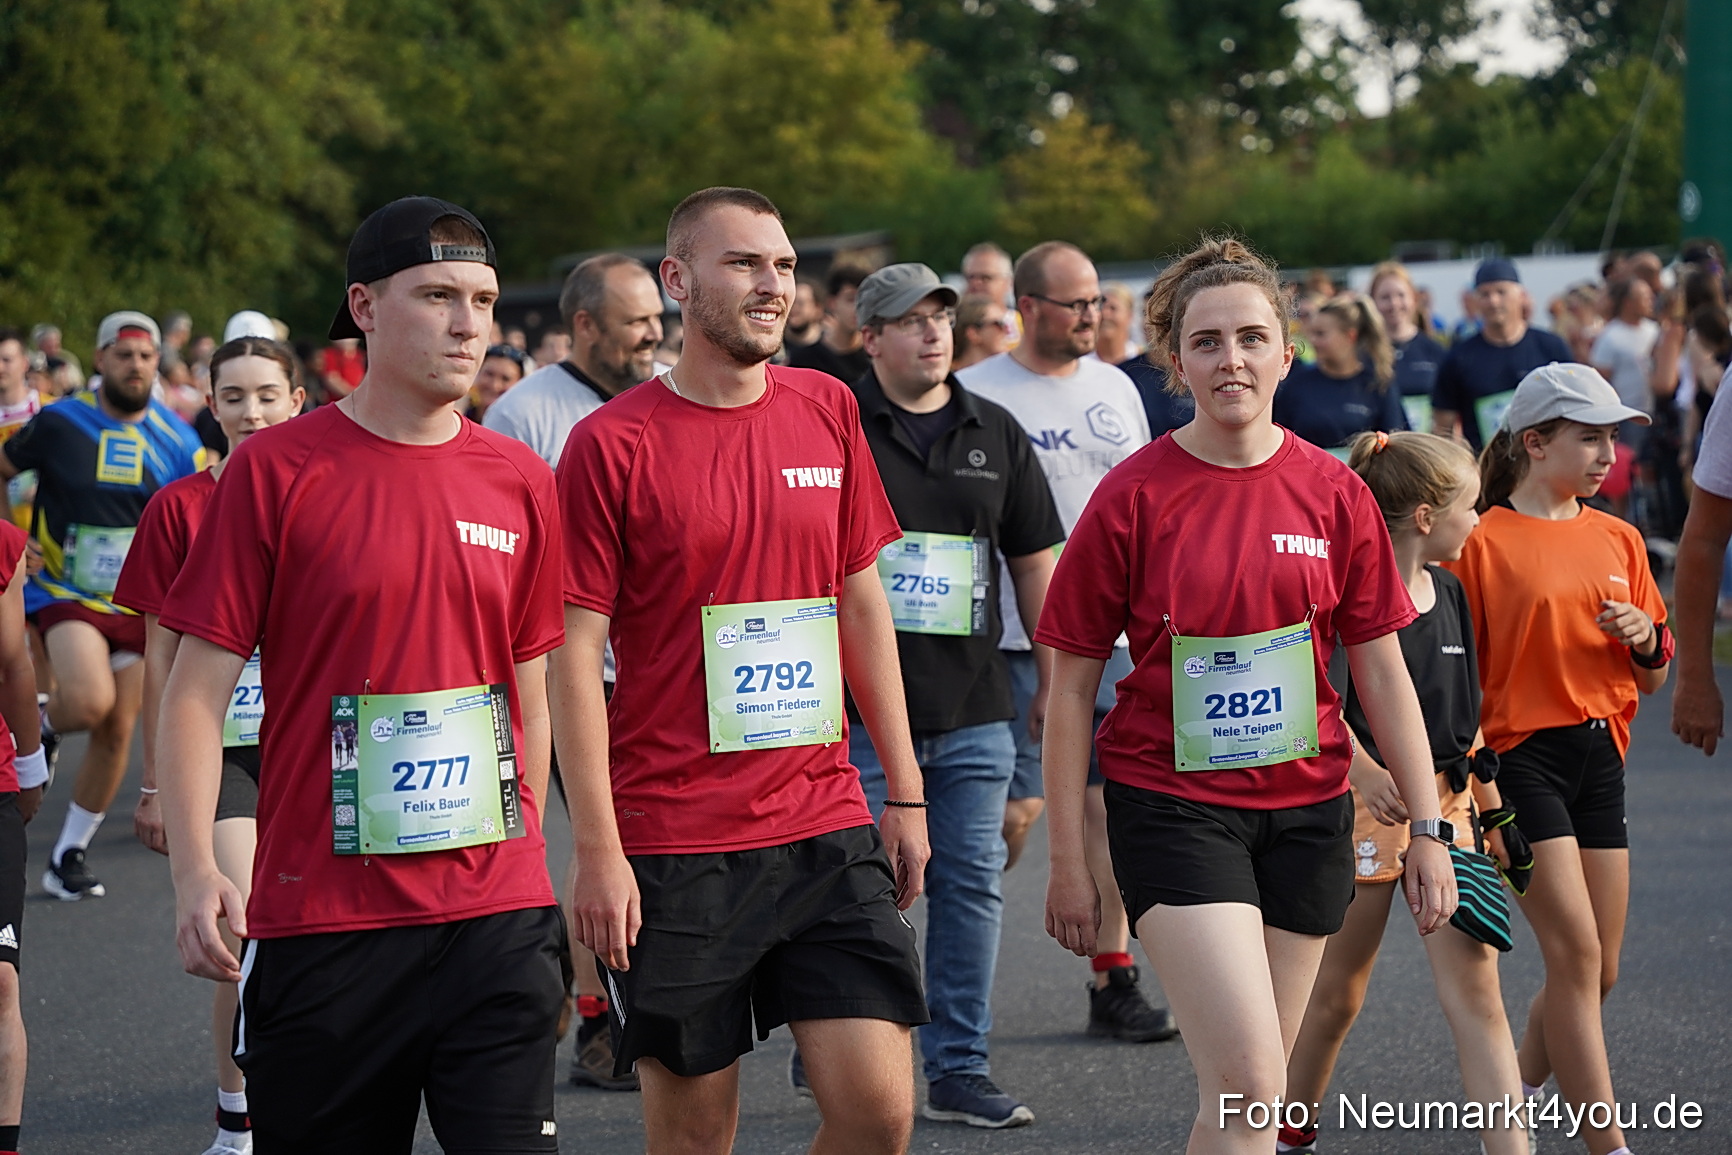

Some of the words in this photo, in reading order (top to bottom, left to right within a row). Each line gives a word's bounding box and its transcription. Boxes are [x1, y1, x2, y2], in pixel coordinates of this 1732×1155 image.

[455, 520, 517, 556] THULE
[1271, 534, 1328, 560] THUL
[891, 573, 950, 595] 2765
[739, 629, 781, 642] Firmenlauf
[756, 637, 781, 645] neumarkt
[1208, 660, 1252, 673] Firmenlauf
[1225, 668, 1252, 676] neumarkt
[734, 660, 815, 694] 2792
[736, 702, 775, 714] Simon
[777, 699, 821, 711] Fiederer
[1204, 686, 1282, 720] 2821
[334, 708, 355, 716] AOK
[396, 722, 443, 736] Firmenlauf
[1212, 727, 1241, 737] Nele
[1243, 722, 1283, 735] Teipen
[392, 755, 470, 792] 2777
[403, 800, 436, 813] Felix
[439, 797, 471, 810] Bauer
[503, 782, 516, 829] HILTL
